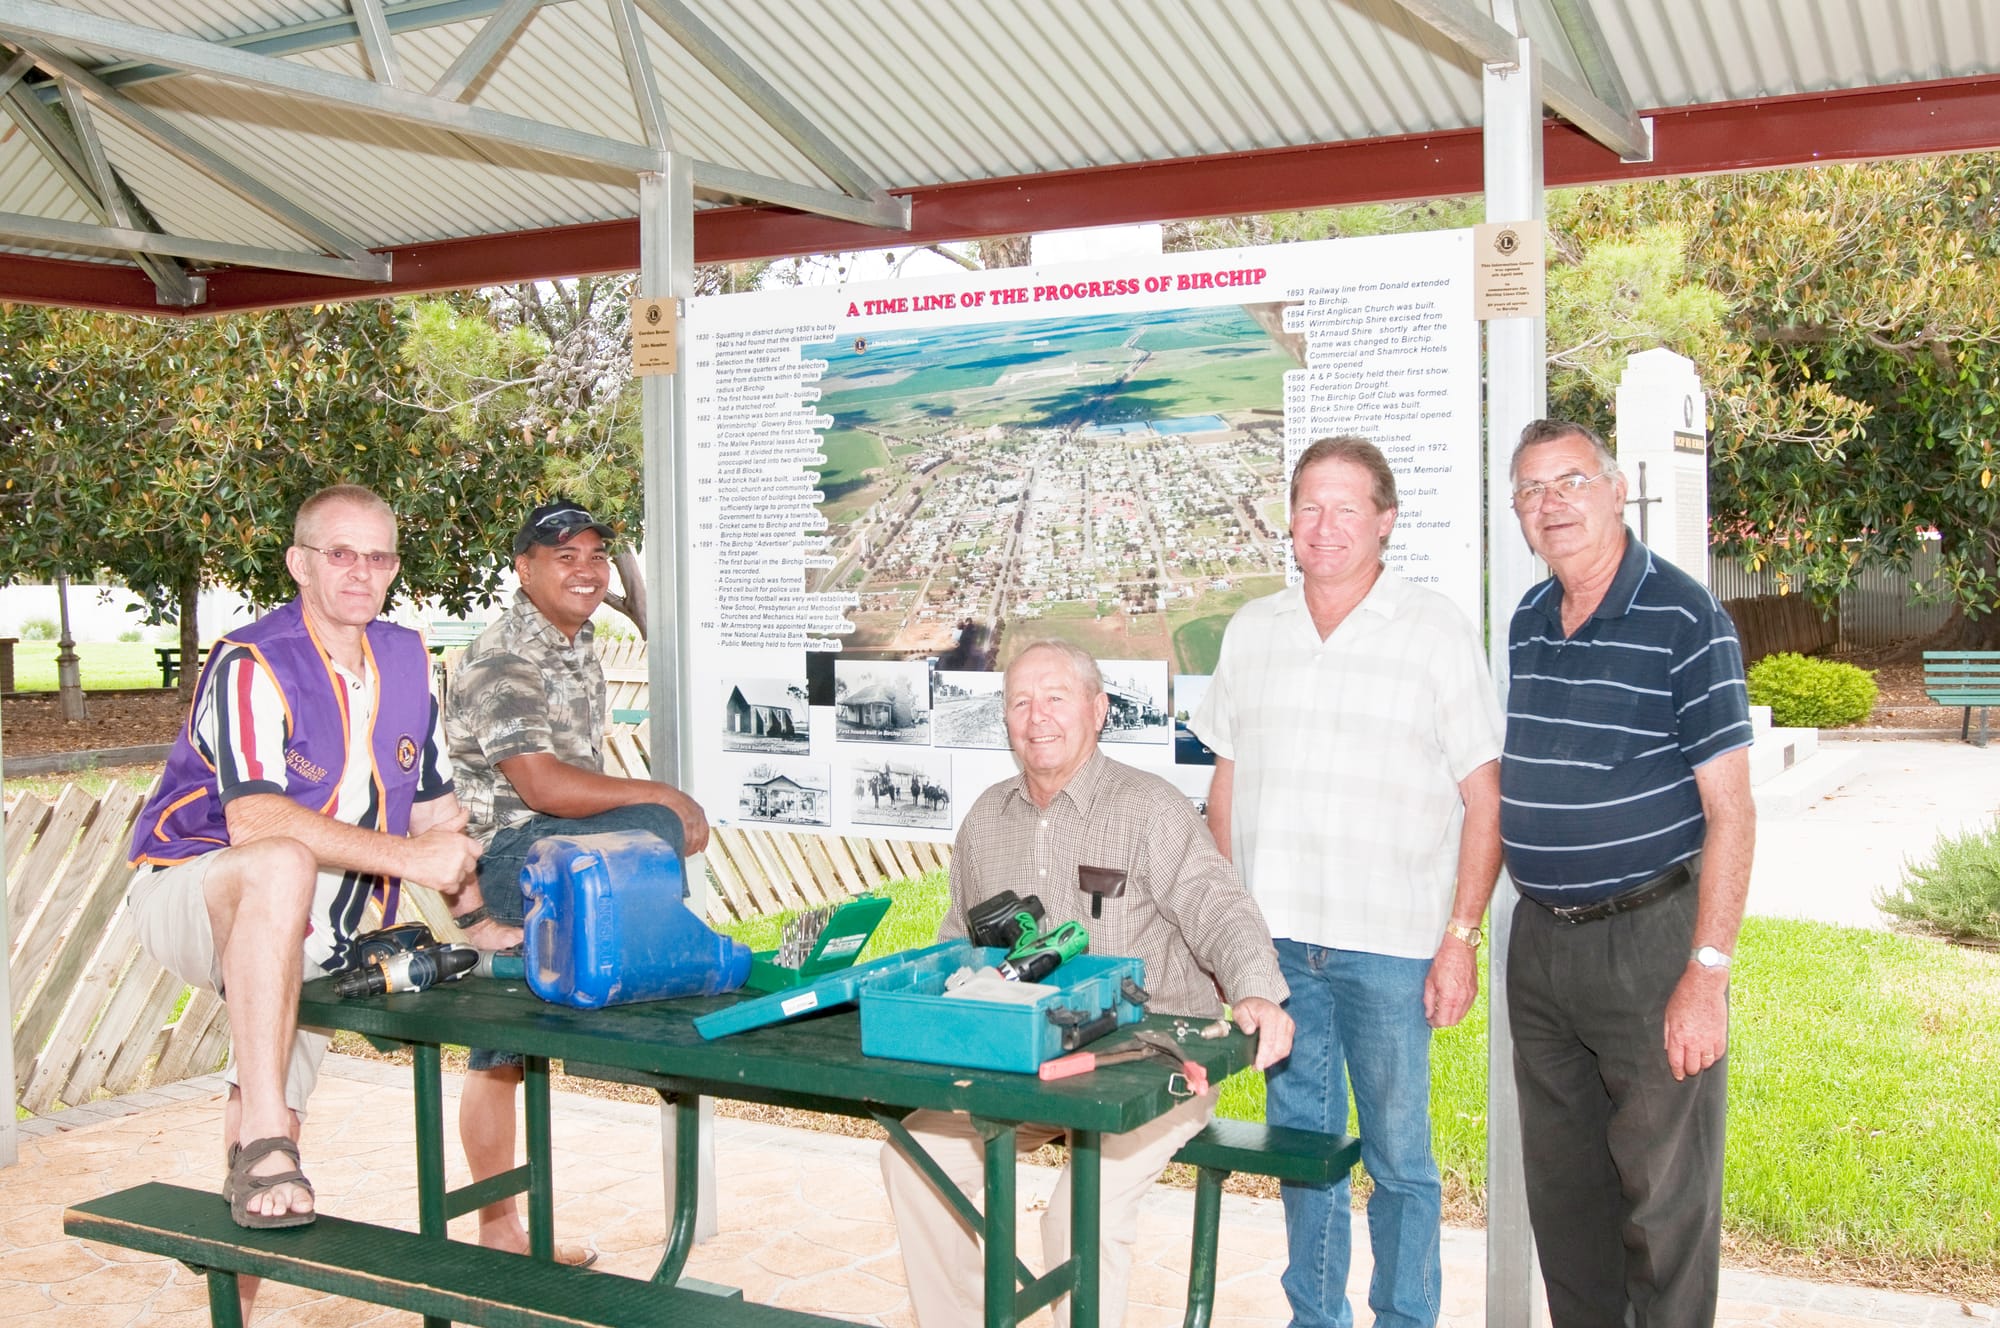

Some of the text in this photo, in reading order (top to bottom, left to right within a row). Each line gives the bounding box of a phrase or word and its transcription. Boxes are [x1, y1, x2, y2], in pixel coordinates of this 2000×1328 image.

[1286, 278, 1450, 296] 1893 Railway line from Donald extended
[846, 268, 1267, 317] A TIME LINE OF THE PROGRESS OF BIRCHIP
[1308, 296, 1350, 307] to Birchip.
[1287, 309, 1304, 317] 1894
[1306, 308, 1325, 316] First
[1327, 306, 1362, 317] Anglican
[1364, 304, 1394, 313] Church
[1287, 312, 1443, 328] 1895 Wirrimbirchip Shire excised from
[695, 323, 836, 341] 1830 Squatting in district during 1830's but by
[1309, 323, 1447, 337] St Arnaud Shire shortly after the
[716, 332, 834, 348] 1840's had found that the district lacked
[1353, 337, 1389, 347] changed
[1391, 336, 1399, 344] to
[1309, 345, 1447, 359] Commercial and Shamrock Hotels
[1333, 360, 1363, 370] opened
[1318, 372, 1324, 380] &
[1326, 372, 1332, 380] P
[1334, 371, 1364, 381] Society
[1366, 370, 1384, 378] held
[1386, 369, 1404, 377] their
[1406, 368, 1423, 376] first
[716, 385, 734, 394] radius
[1288, 384, 1305, 392] 1902
[1310, 382, 1352, 391] Federation
[1288, 394, 1305, 402] 1903
[1311, 393, 1325, 401] The
[1327, 392, 1356, 402] Birchip
[1358, 391, 1375, 399] Golf
[1377, 391, 1396, 399] Club
[1417, 389, 1448, 397] formed.
[1288, 405, 1306, 413] 1906
[1310, 404, 1331, 412] Brick
[1333, 403, 1354, 411] Shire
[1356, 402, 1380, 410] Office
[1401, 401, 1421, 409] built.
[1288, 416, 1305, 424] 1907
[1310, 414, 1351, 423] Woodview
[1353, 413, 1382, 421] Private
[1384, 412, 1418, 422] Hospital
[1310, 426, 1333, 434] Water
[1335, 425, 1358, 433] tower
[1288, 438, 1306, 446] 1911
[1368, 433, 1412, 443] stablished.
[1388, 444, 1415, 452] closed
[1417, 444, 1425, 452] in
[1392, 465, 1452, 474] diers Memorial
[758, 521, 765, 529] to
[765, 521, 788, 530] Birchip
[813, 520, 825, 528] first
[1416, 520, 1450, 528] donated
[720, 530, 742, 539] Birchip
[743, 530, 759, 538] Hotel
[731, 539, 753, 548] Birchip
[755, 539, 791, 547] "Advertiser"
[792, 539, 823, 548] published
[1410, 553, 1431, 561] Club.
[718, 576, 723, 584] A
[724, 576, 752, 585] Coursing
[1430, 575, 1439, 583] to
[759, 631, 786, 639] Australia
[787, 631, 803, 639] Bank
[741, 640, 764, 649] Meeting
[787, 640, 802, 648] form
[803, 640, 821, 648] Water
